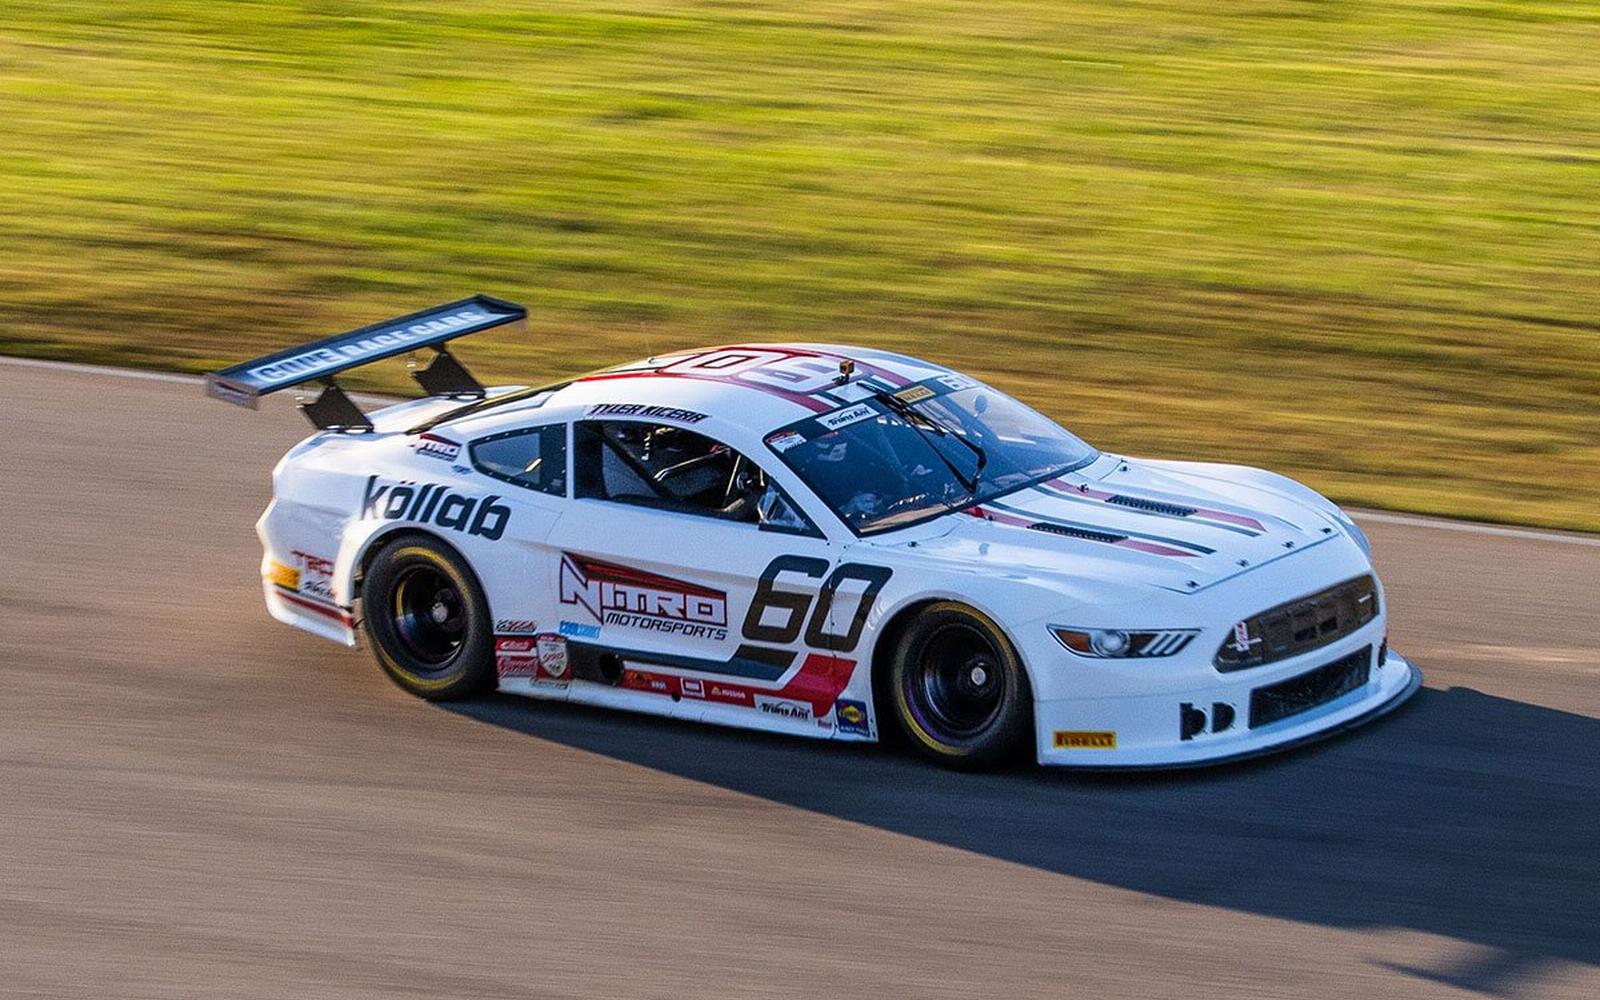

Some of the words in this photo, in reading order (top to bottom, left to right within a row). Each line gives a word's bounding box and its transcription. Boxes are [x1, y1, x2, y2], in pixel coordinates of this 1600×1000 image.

[337, 330, 418, 356] RACE
[407, 311, 487, 336] CARS
[586, 403, 645, 416] TYLER
[827, 411, 854, 427] Trans
[361, 474, 512, 541] köllab
[559, 553, 728, 627] NITRO
[742, 554, 893, 652] 60
[605, 611, 729, 641] MOTORSPORTS
[760, 701, 790, 717] Trans
[790, 706, 812, 720] Am
